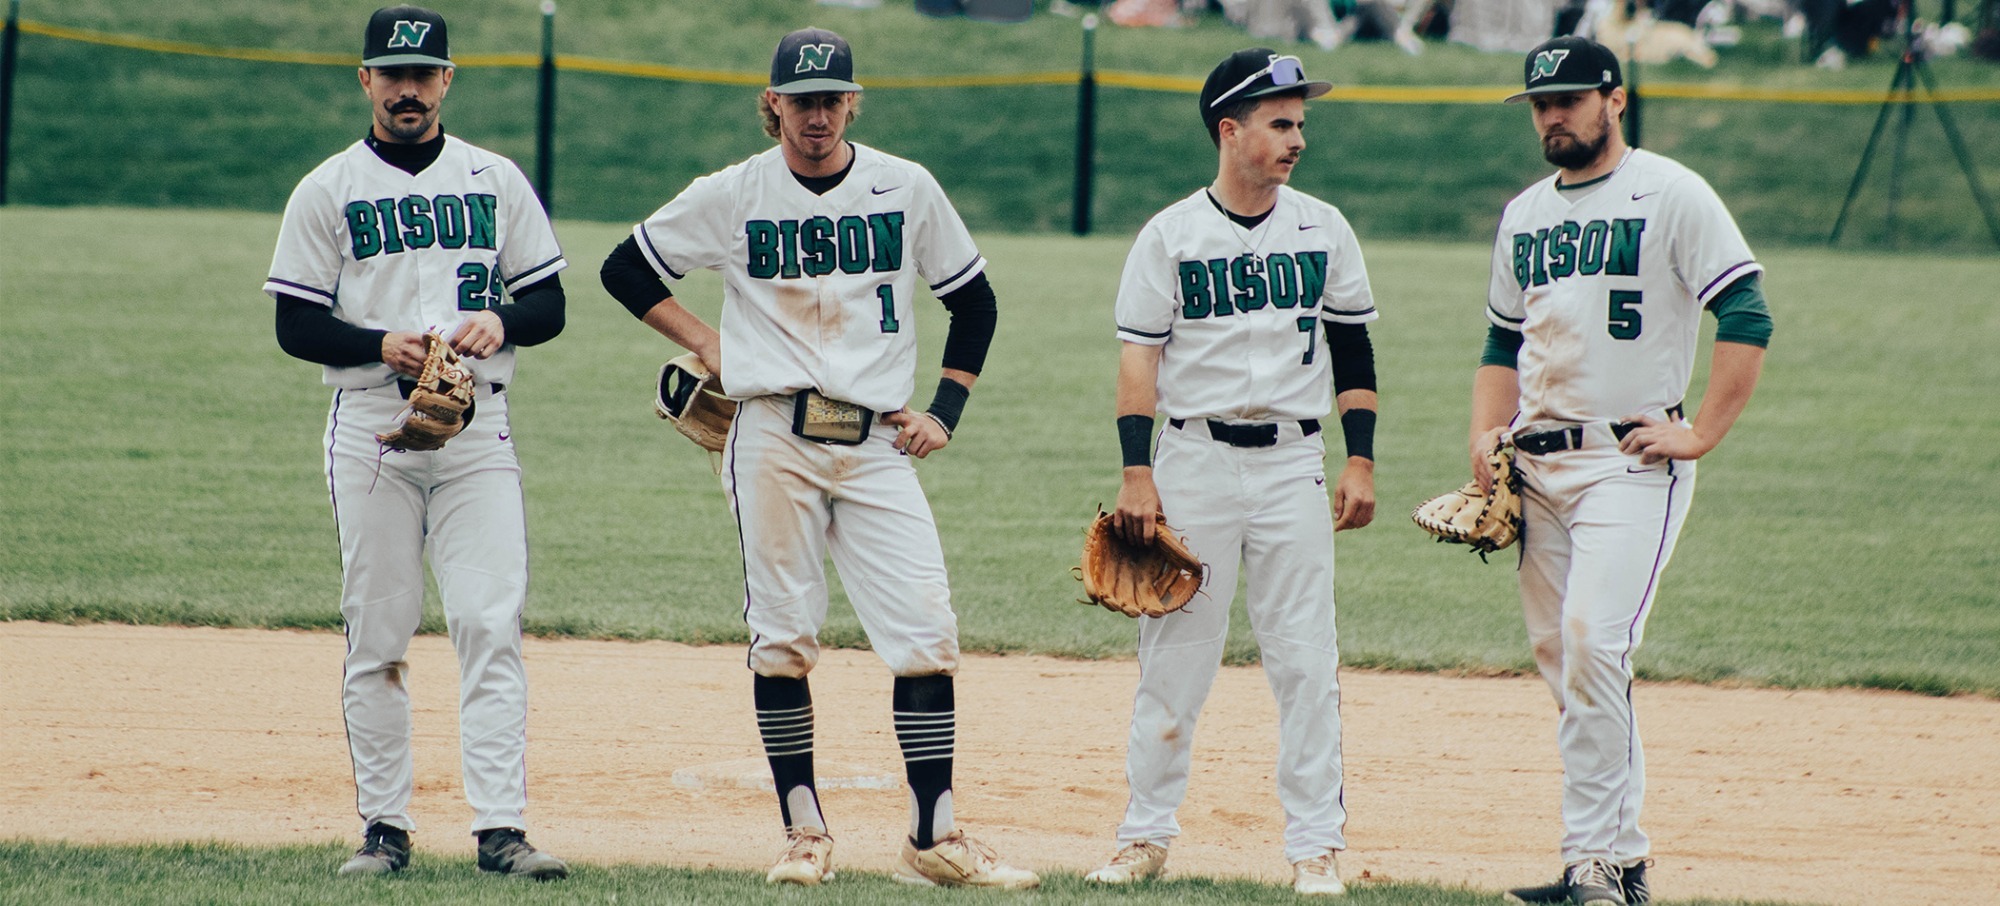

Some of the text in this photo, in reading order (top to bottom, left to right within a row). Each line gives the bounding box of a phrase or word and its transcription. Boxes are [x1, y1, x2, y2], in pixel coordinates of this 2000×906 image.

[388, 20, 430, 48] N
[795, 44, 835, 73] N
[1529, 49, 1570, 83] N
[345, 193, 498, 261] BISON
[745, 211, 905, 280] BISON
[1512, 218, 1646, 292] BISON
[876, 283, 900, 334] 1
[1178, 251, 1328, 319] BISON
[1608, 289, 1643, 340] 5
[1296, 316, 1318, 365] 7
